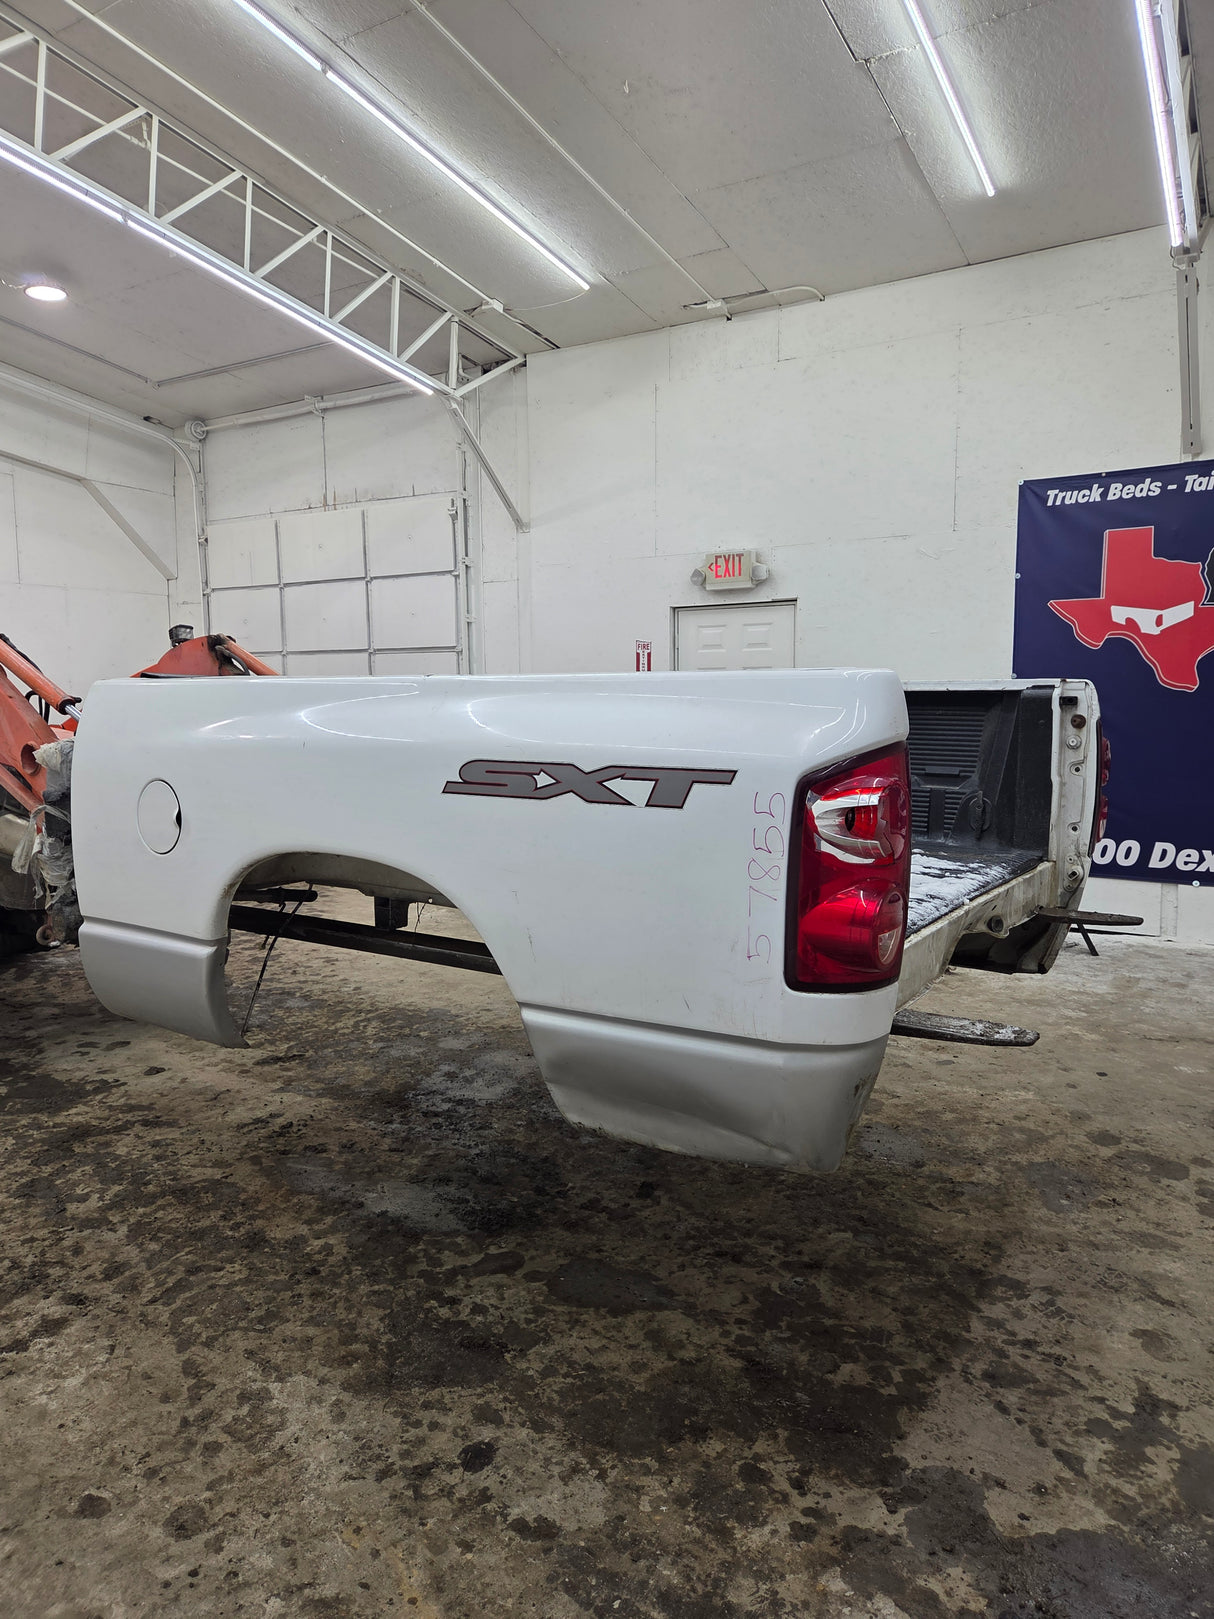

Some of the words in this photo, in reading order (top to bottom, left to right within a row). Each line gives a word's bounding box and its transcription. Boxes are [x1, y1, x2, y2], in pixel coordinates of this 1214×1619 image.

[1046, 483, 1105, 507] Truck
[1106, 477, 1162, 501] Beds
[714, 553, 745, 579] EXIT
[637, 643, 650, 651] FIRE
[442, 759, 738, 809] SXT
[1148, 841, 1214, 873] Dex
